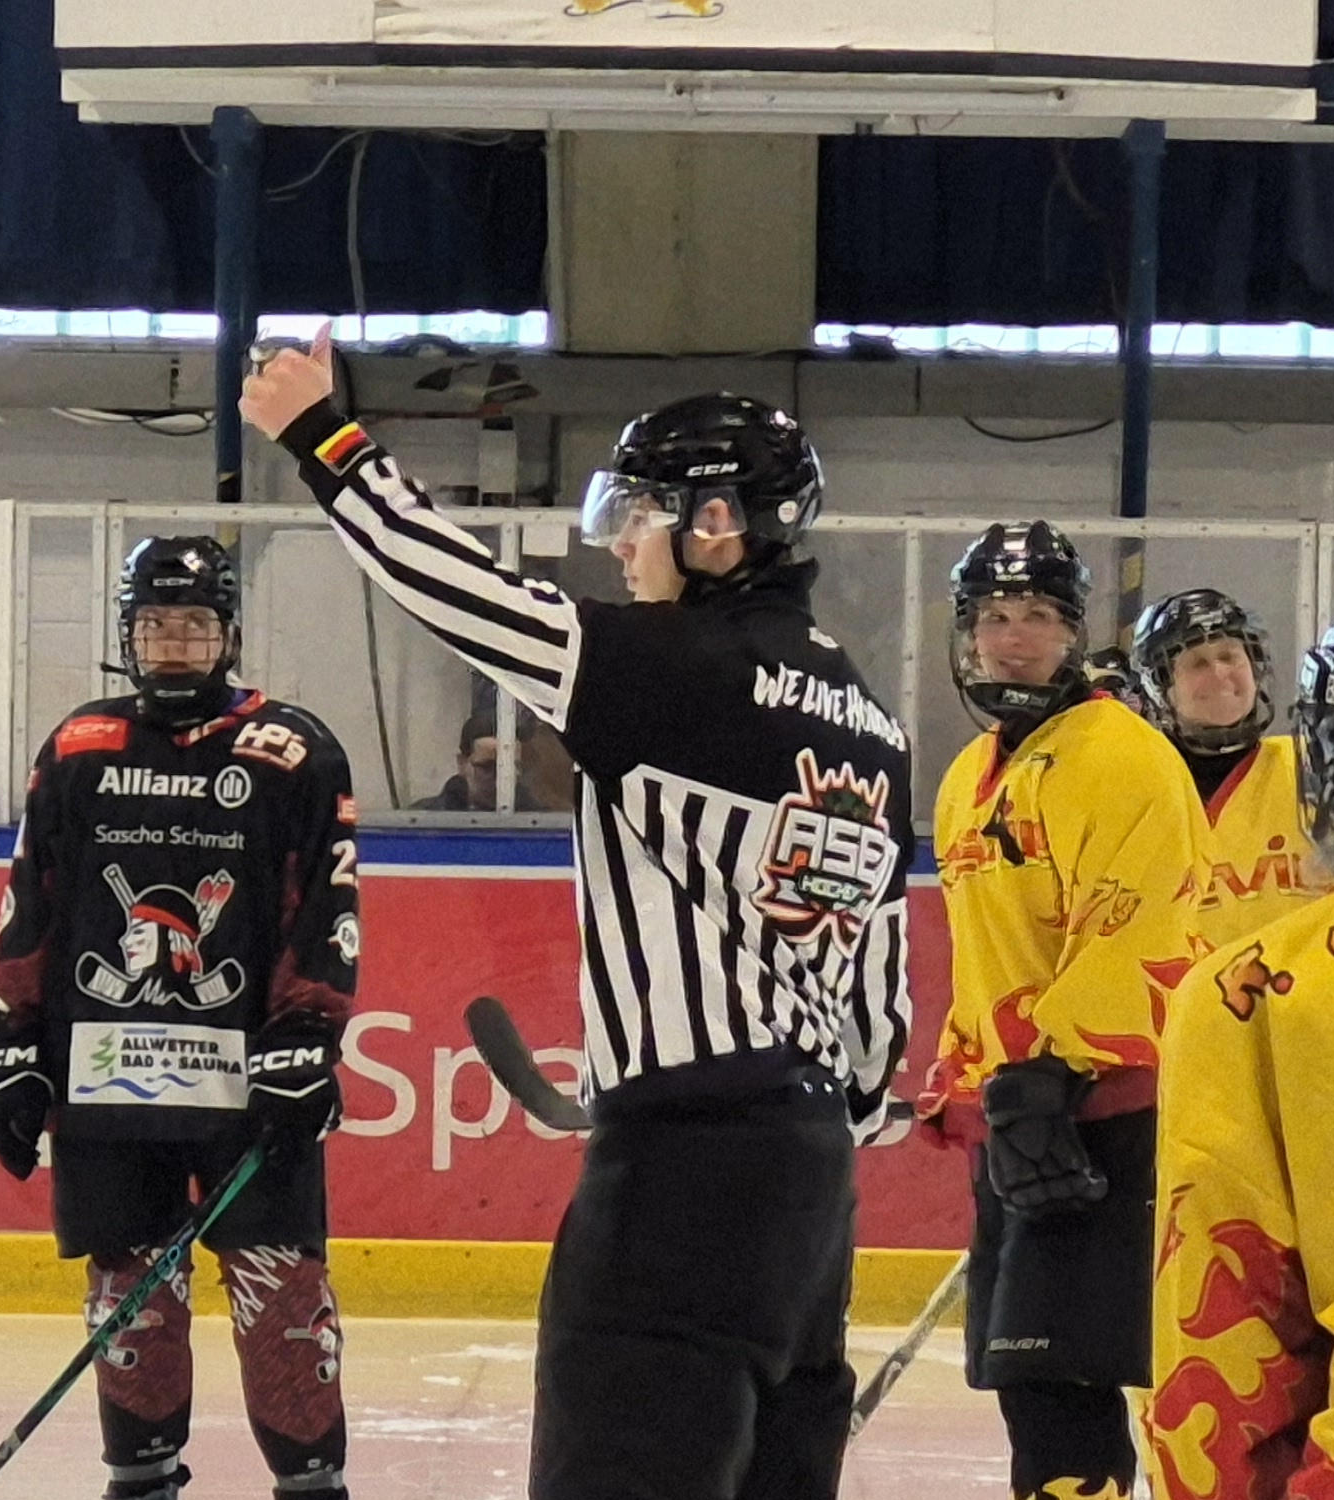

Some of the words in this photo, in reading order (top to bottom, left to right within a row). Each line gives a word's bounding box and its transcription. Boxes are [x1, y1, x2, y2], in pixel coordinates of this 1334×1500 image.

[97, 766, 208, 798] Allianz
[94, 824, 165, 845] Sascha
[169, 826, 245, 850] Schmidt
[120, 1037, 220, 1055] ALLWETTER
[120, 1054, 155, 1068] BAD
[178, 1058, 243, 1076] SAUNA
[247, 1046, 324, 1076] CCM
